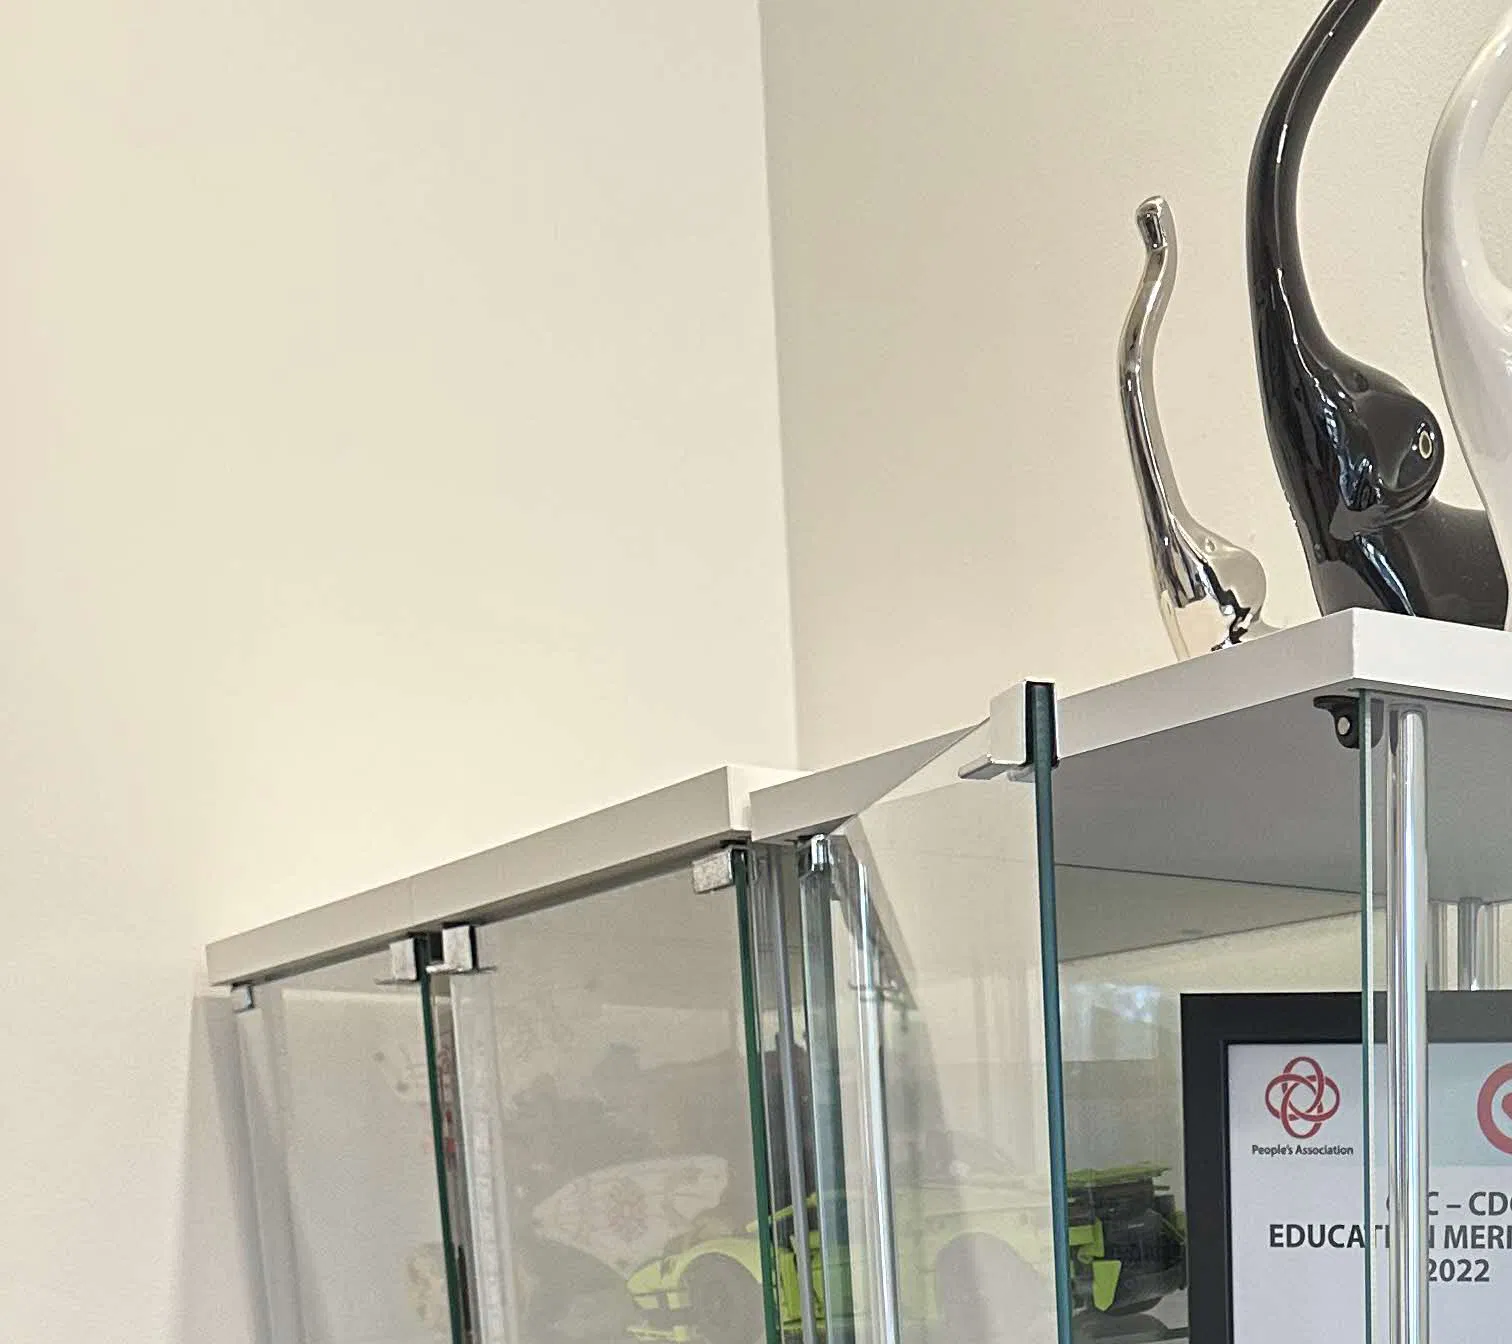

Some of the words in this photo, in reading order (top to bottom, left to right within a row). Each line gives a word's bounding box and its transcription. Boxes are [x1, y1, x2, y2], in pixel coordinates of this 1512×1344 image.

[1252, 1144, 1293, 1157] People's
[1295, 1144, 1354, 1155] Association
[1427, 1258, 1490, 1282] 2022
